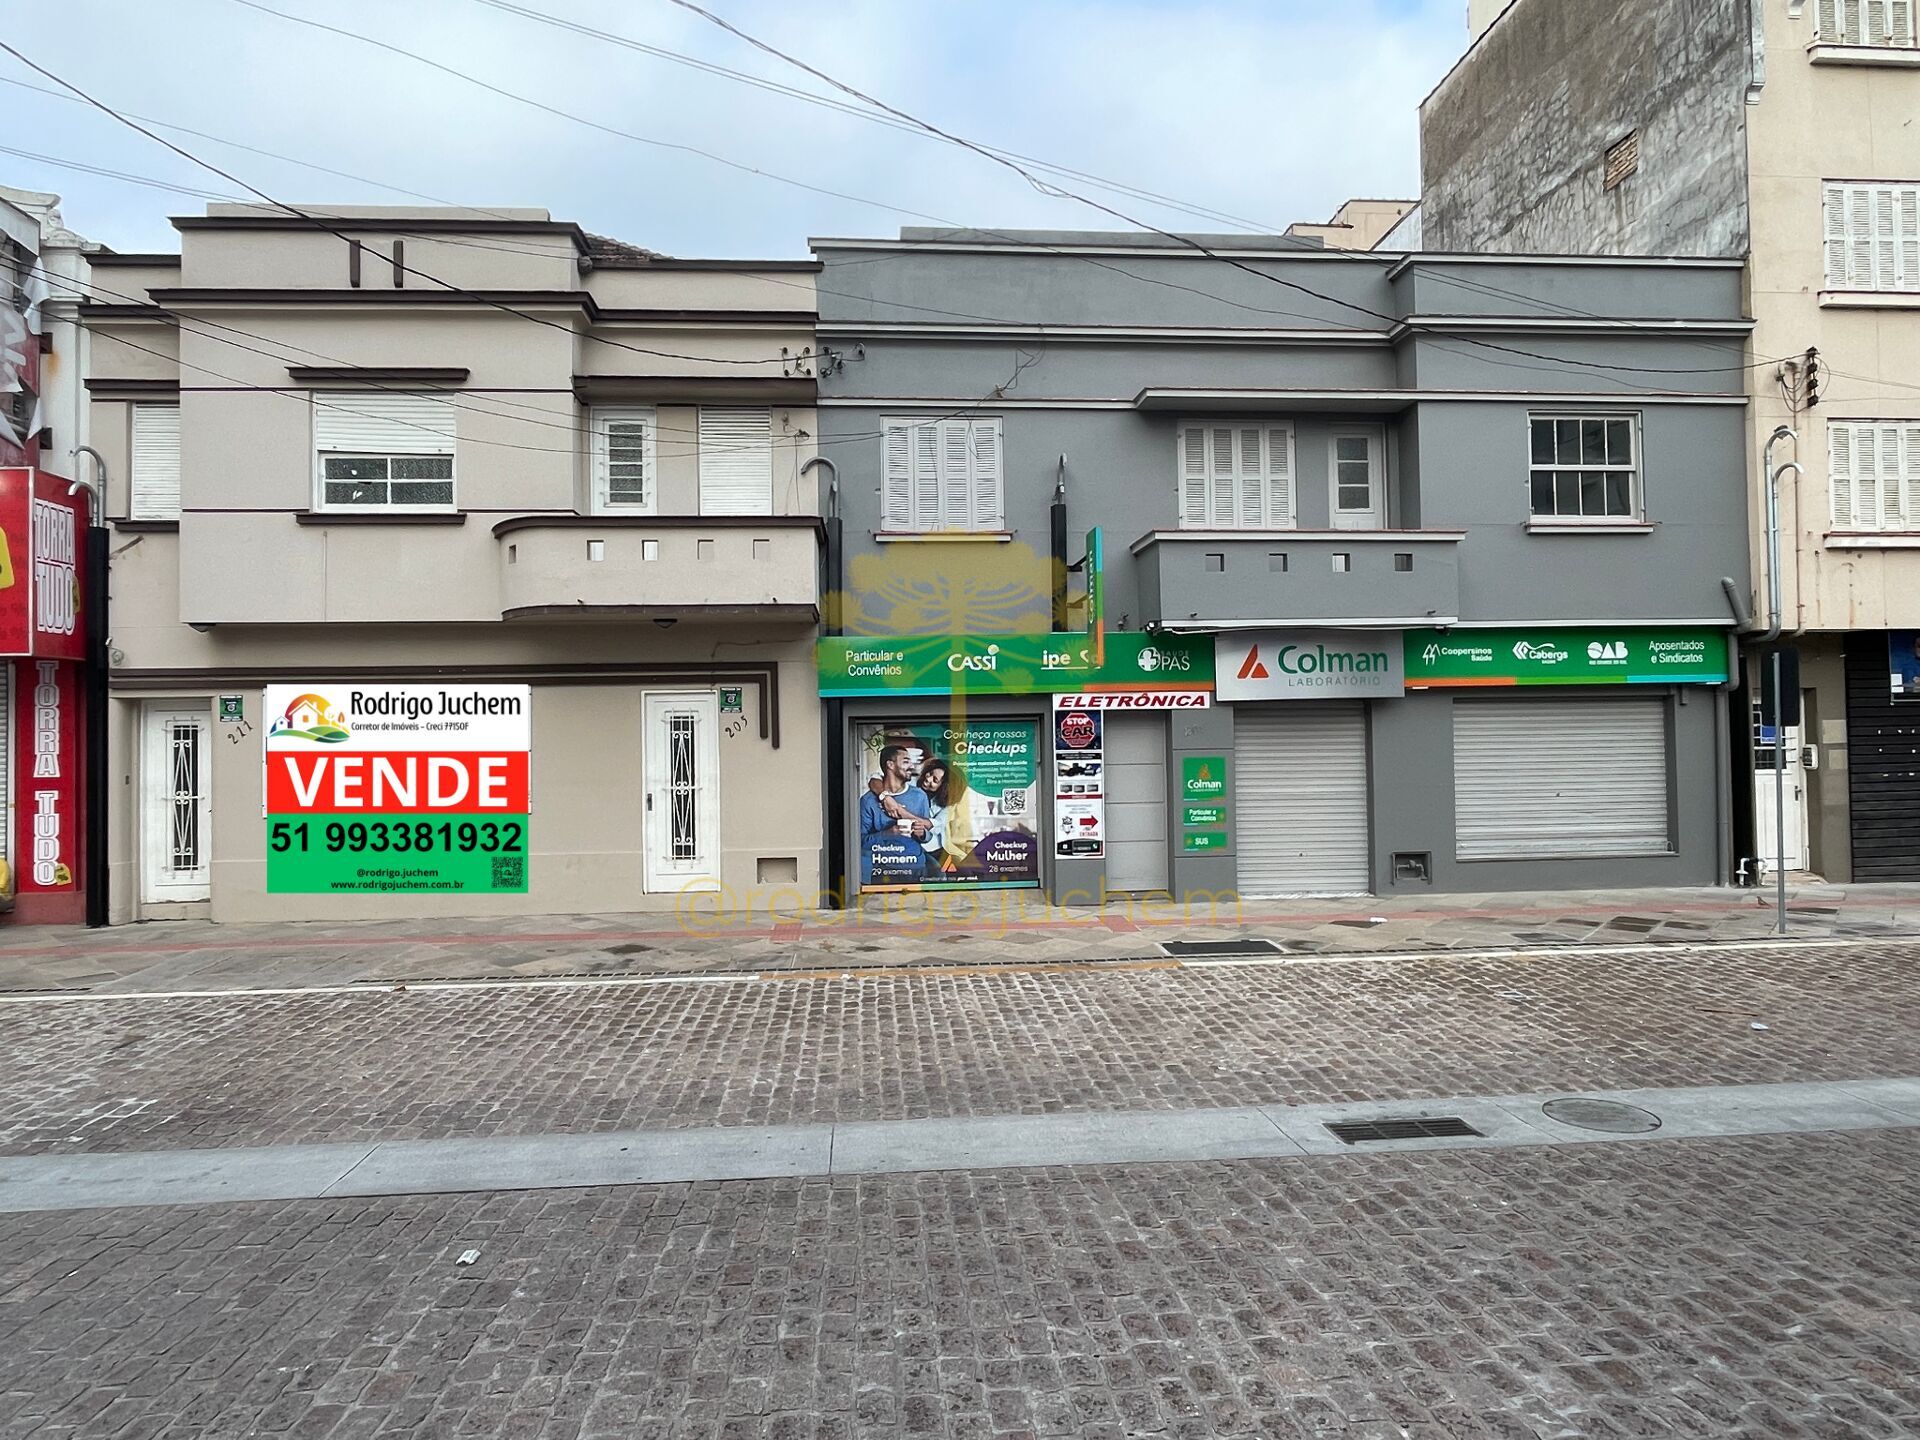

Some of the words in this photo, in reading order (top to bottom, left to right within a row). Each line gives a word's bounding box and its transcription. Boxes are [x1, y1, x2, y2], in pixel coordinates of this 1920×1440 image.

[34, 498, 75, 564] TORRA
[35, 562, 76, 635] TUDO
[1587, 641, 1629, 660] OAB
[1649, 640, 1705, 652] Aposentados
[845, 650, 894, 662] Particular
[896, 652, 904, 661] e
[1042, 649, 1071, 668] ipe
[1277, 644, 1389, 675] Colman
[1529, 652, 1568, 663] Cabergs
[1650, 655, 1657, 663] e
[1659, 652, 1704, 663] Sindicatos
[1161, 655, 1191, 671] PAS
[847, 664, 903, 676] Convênios
[1288, 675, 1381, 687] LABORATÓRIO
[351, 691, 433, 720] Rodrigo
[438, 691, 521, 716] Juchem
[1058, 693, 1206, 708] ELETRÔNICA
[33, 660, 62, 777] TORRA
[1066, 717, 1090, 725] STOP
[227, 720, 254, 744] 211
[351, 722, 379, 731] Corretor
[381, 722, 390, 731] de
[391, 722, 420, 731] Imóveis
[426, 722, 443, 731] Creci
[725, 715, 748, 738] 205
[1061, 727, 1095, 737] CAR
[943, 729, 991, 740] Conheça
[954, 741, 1028, 758] Checkups
[284, 756, 508, 808] VENDE
[1187, 779, 1222, 789] Colman
[34, 791, 60, 886] TUDO
[271, 822, 309, 852] 51
[325, 822, 522, 852] 993381932
[1195, 837, 1209, 845] SUS
[871, 844, 906, 853] Checkup
[994, 841, 1028, 850] Checkup
[872, 854, 917, 864] Homem
[986, 850, 1028, 862] Mulher
[356, 868, 439, 879] @rodrigo.juchem
[872, 868, 882, 876] 29
[883, 868, 913, 876] exames
[331, 880, 465, 891] www.rodrigojuchem.com.br
